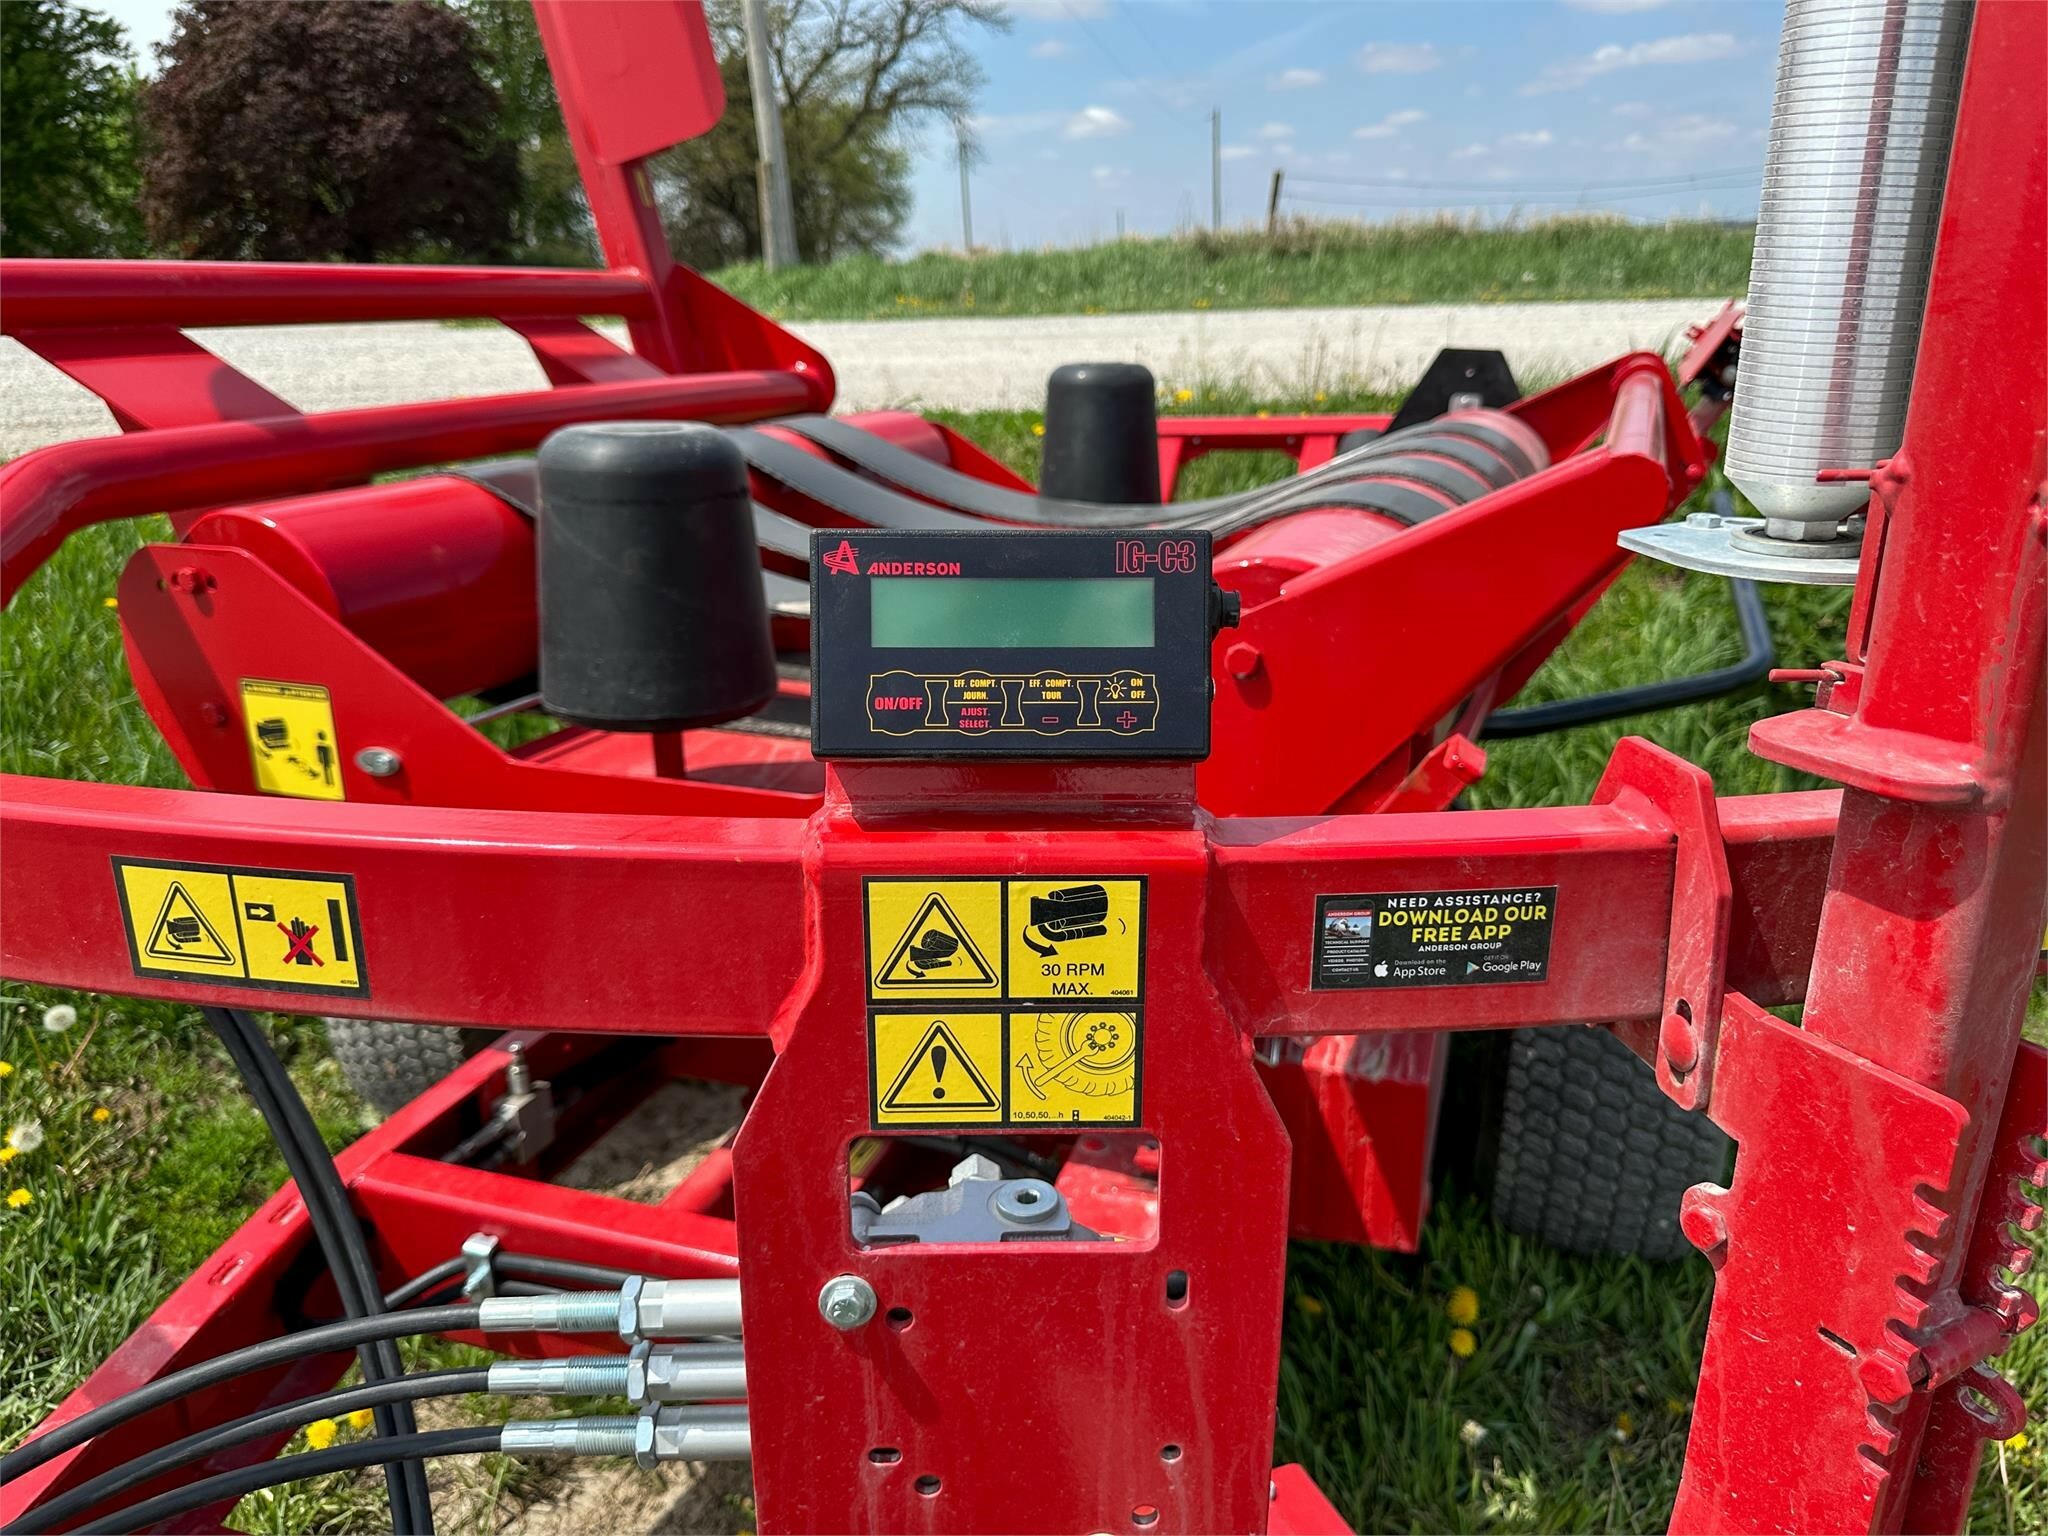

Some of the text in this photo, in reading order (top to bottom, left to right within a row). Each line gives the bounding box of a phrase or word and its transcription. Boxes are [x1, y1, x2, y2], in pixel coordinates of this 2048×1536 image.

[1115, 540, 1197, 574] IG-C3
[866, 562, 961, 576] ANDERSON
[953, 679, 998, 688] EFF. COMPT.
[1029, 679, 1074, 688] EFF. COMPT.
[1130, 678, 1143, 687] ON
[962, 691, 989, 700] JOURN.
[1042, 691, 1062, 700] TOUR
[1130, 690, 1146, 699] OFF
[874, 697, 923, 710] ON/OFF
[1387, 892, 1541, 909] NEED ASSISTANCE?
[1378, 905, 1547, 927] DOWNLOAD OUR
[1411, 924, 1512, 943] FREE APP
[1418, 942, 1502, 952] ANDERSON GROUP
[1041, 963, 1105, 976] 30 RPM
[1393, 966, 1446, 979] App Store
[1482, 960, 1542, 973] Google Play
[1052, 982, 1093, 995] MAX.
